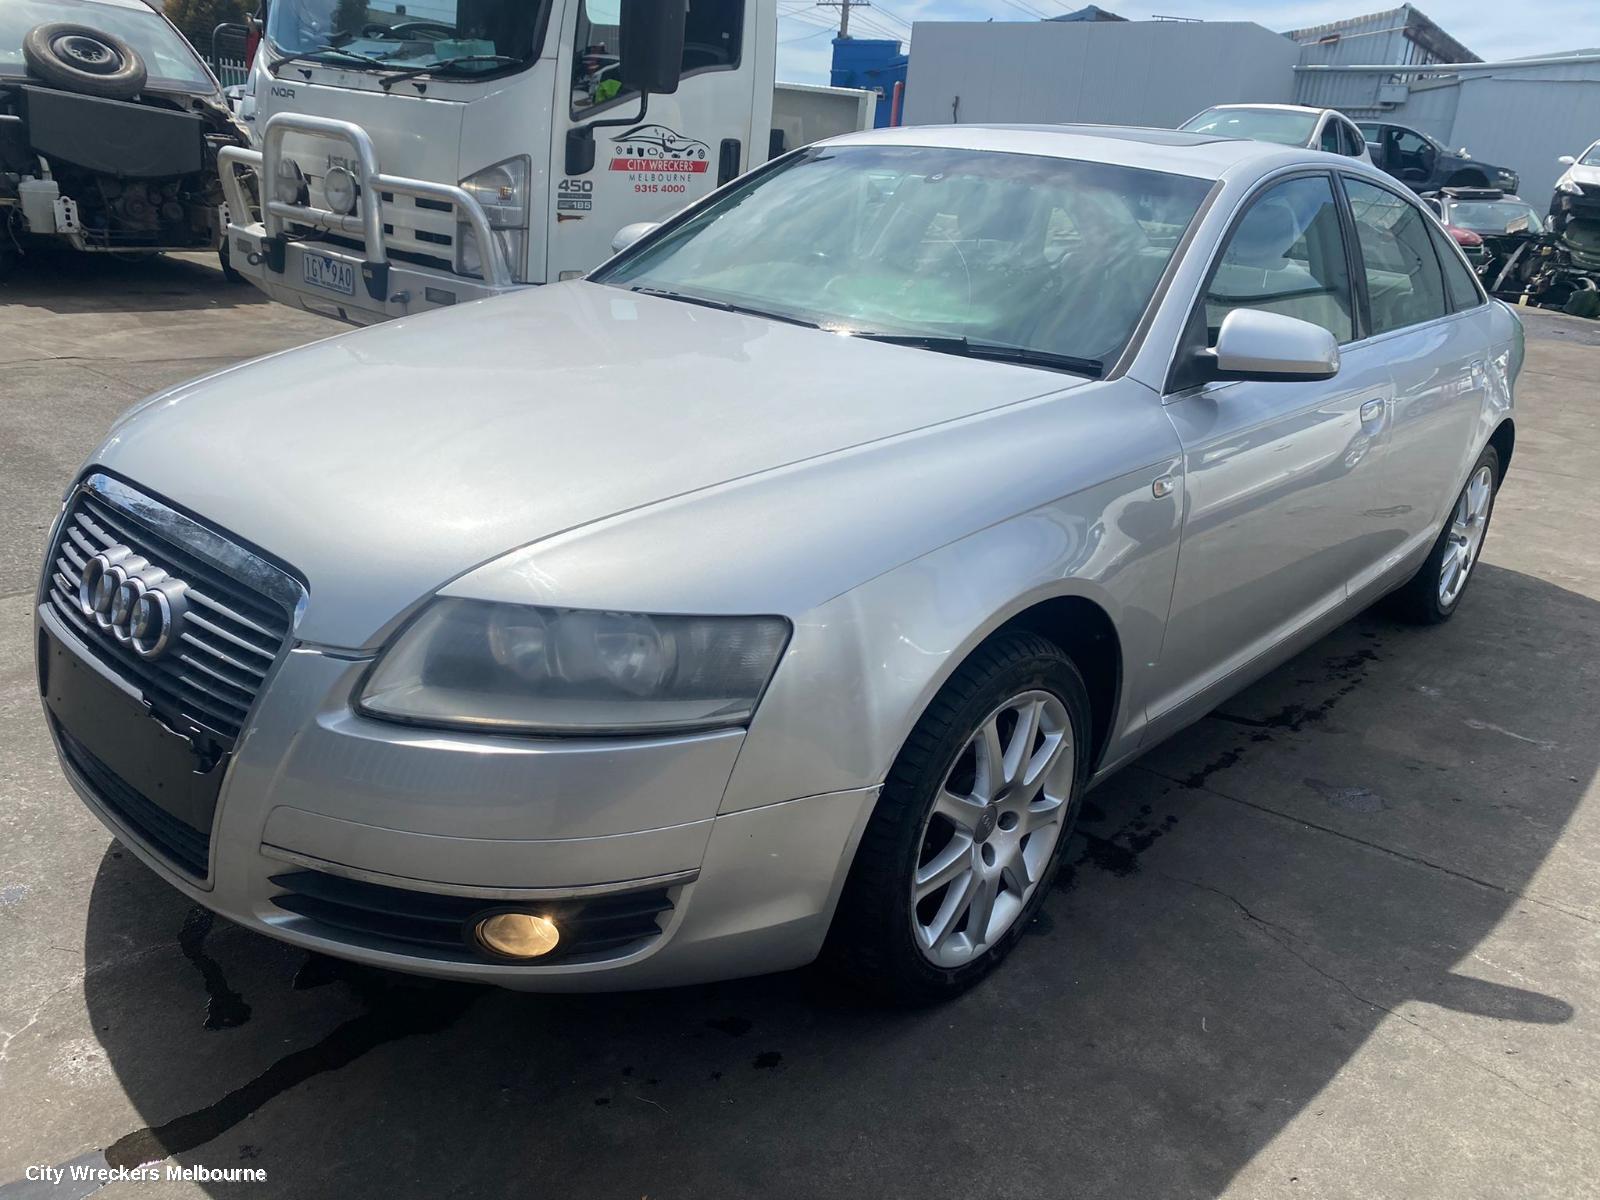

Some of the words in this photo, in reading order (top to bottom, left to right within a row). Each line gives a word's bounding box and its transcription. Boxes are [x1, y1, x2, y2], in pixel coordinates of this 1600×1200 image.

[270, 87, 296, 99] NQR
[627, 159, 648, 171] CITY
[649, 160, 694, 172] WRECKERS
[628, 173, 692, 182] MELBOURNE
[558, 179, 593, 192] 450
[634, 184, 658, 193] 9315
[661, 184, 686, 193] 4000
[305, 256, 324, 281] 1GY
